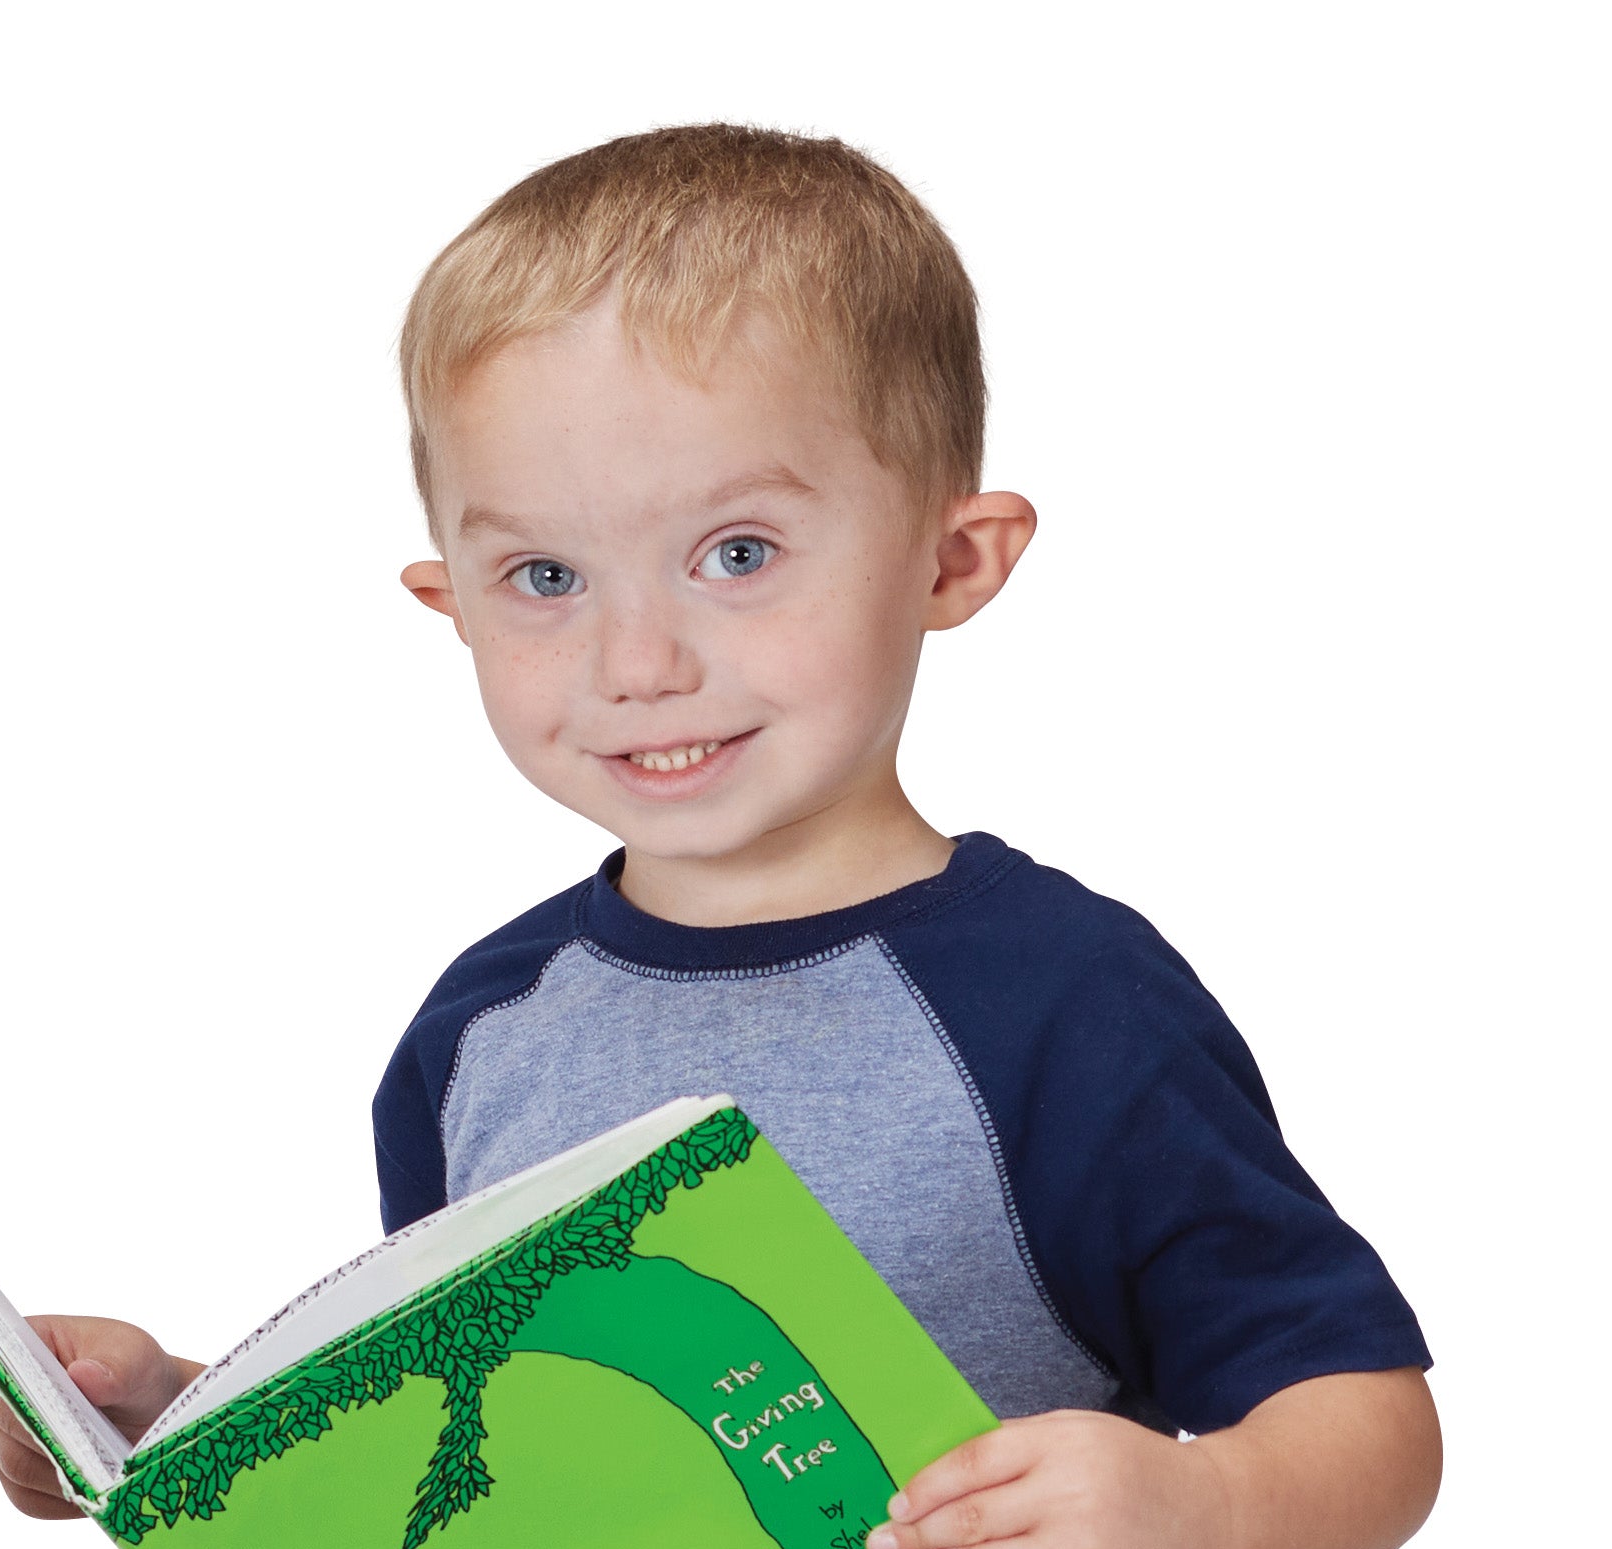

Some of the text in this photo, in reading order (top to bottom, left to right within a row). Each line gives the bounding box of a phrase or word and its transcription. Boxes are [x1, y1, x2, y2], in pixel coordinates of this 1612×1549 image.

[713, 1360, 765, 1396] The
[711, 1380, 825, 1451] Giving
[762, 1437, 838, 1483] Tree
[818, 1499, 844, 1520] by
